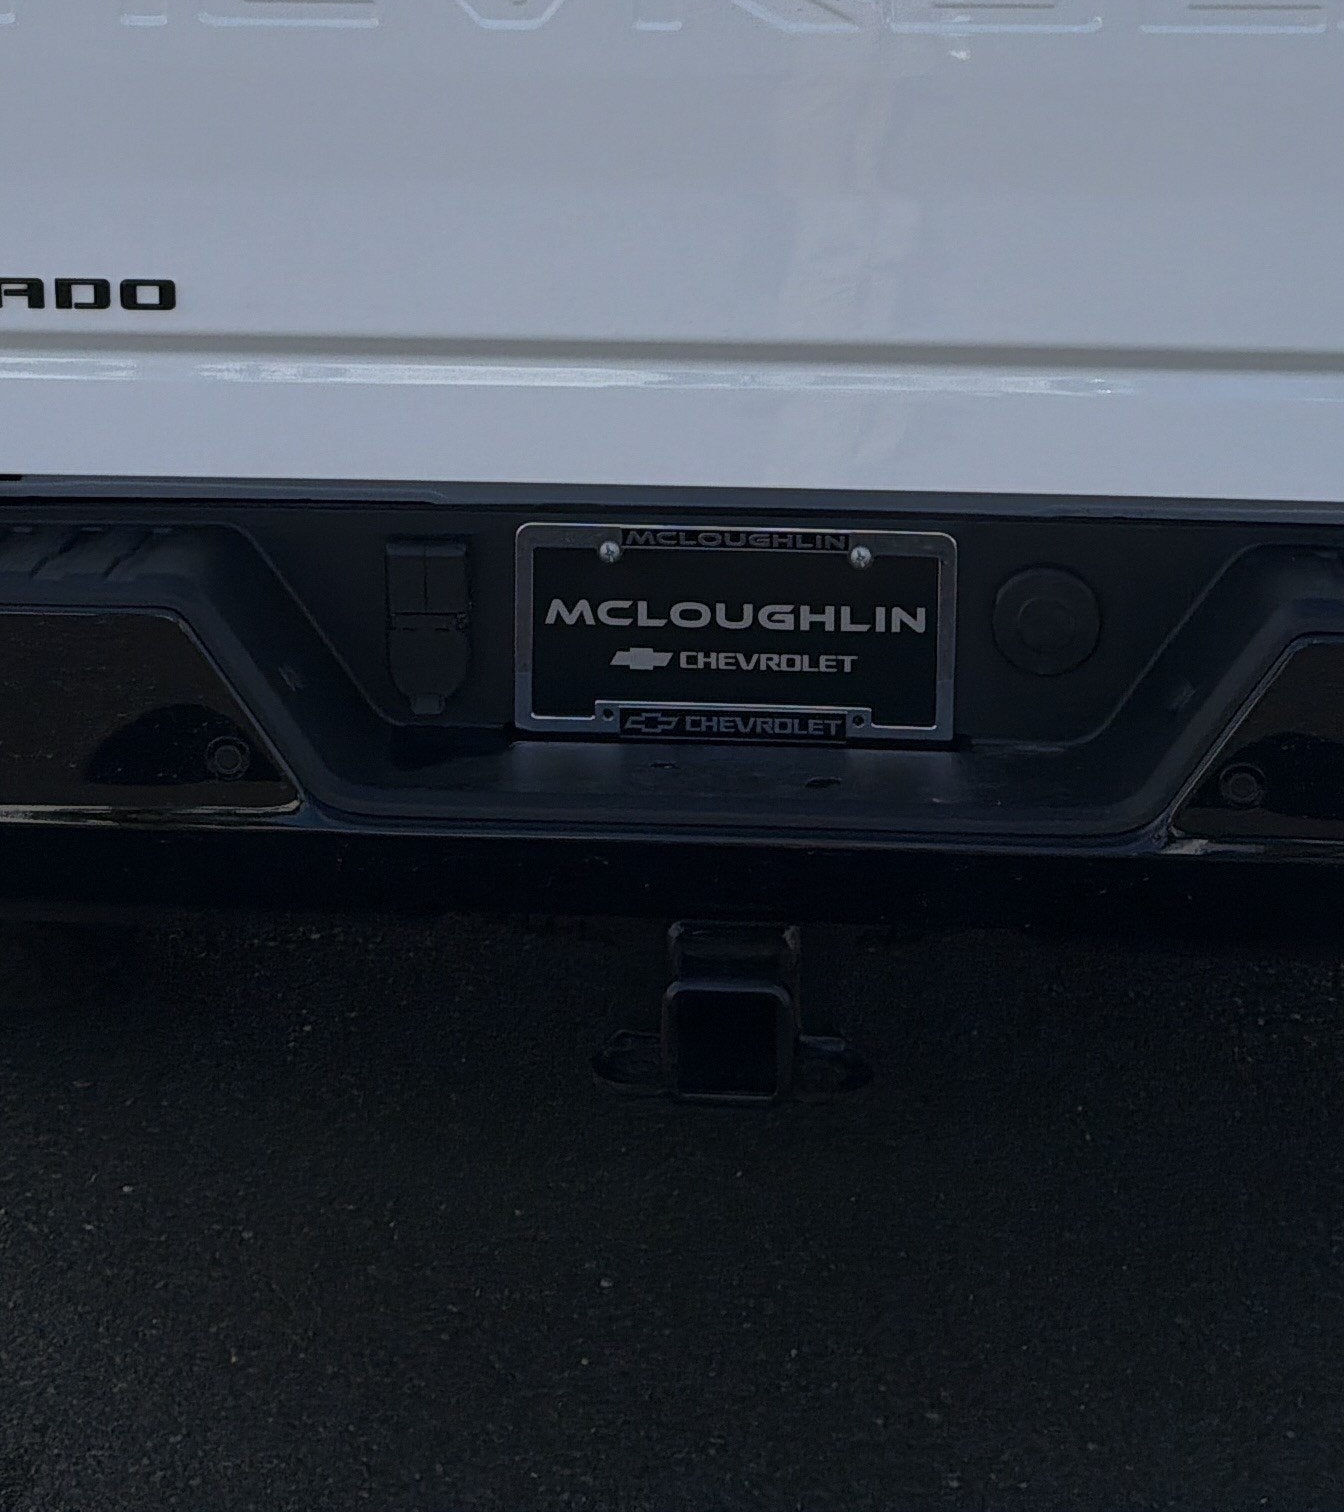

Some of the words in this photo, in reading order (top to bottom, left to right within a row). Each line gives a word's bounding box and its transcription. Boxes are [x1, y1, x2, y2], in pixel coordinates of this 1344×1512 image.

[624, 529, 850, 551] MCLOUGHLIN
[545, 598, 927, 634] MCLOUGHLIN
[679, 650, 858, 673] CHEVROLET
[685, 714, 844, 738] CHEVROLET
